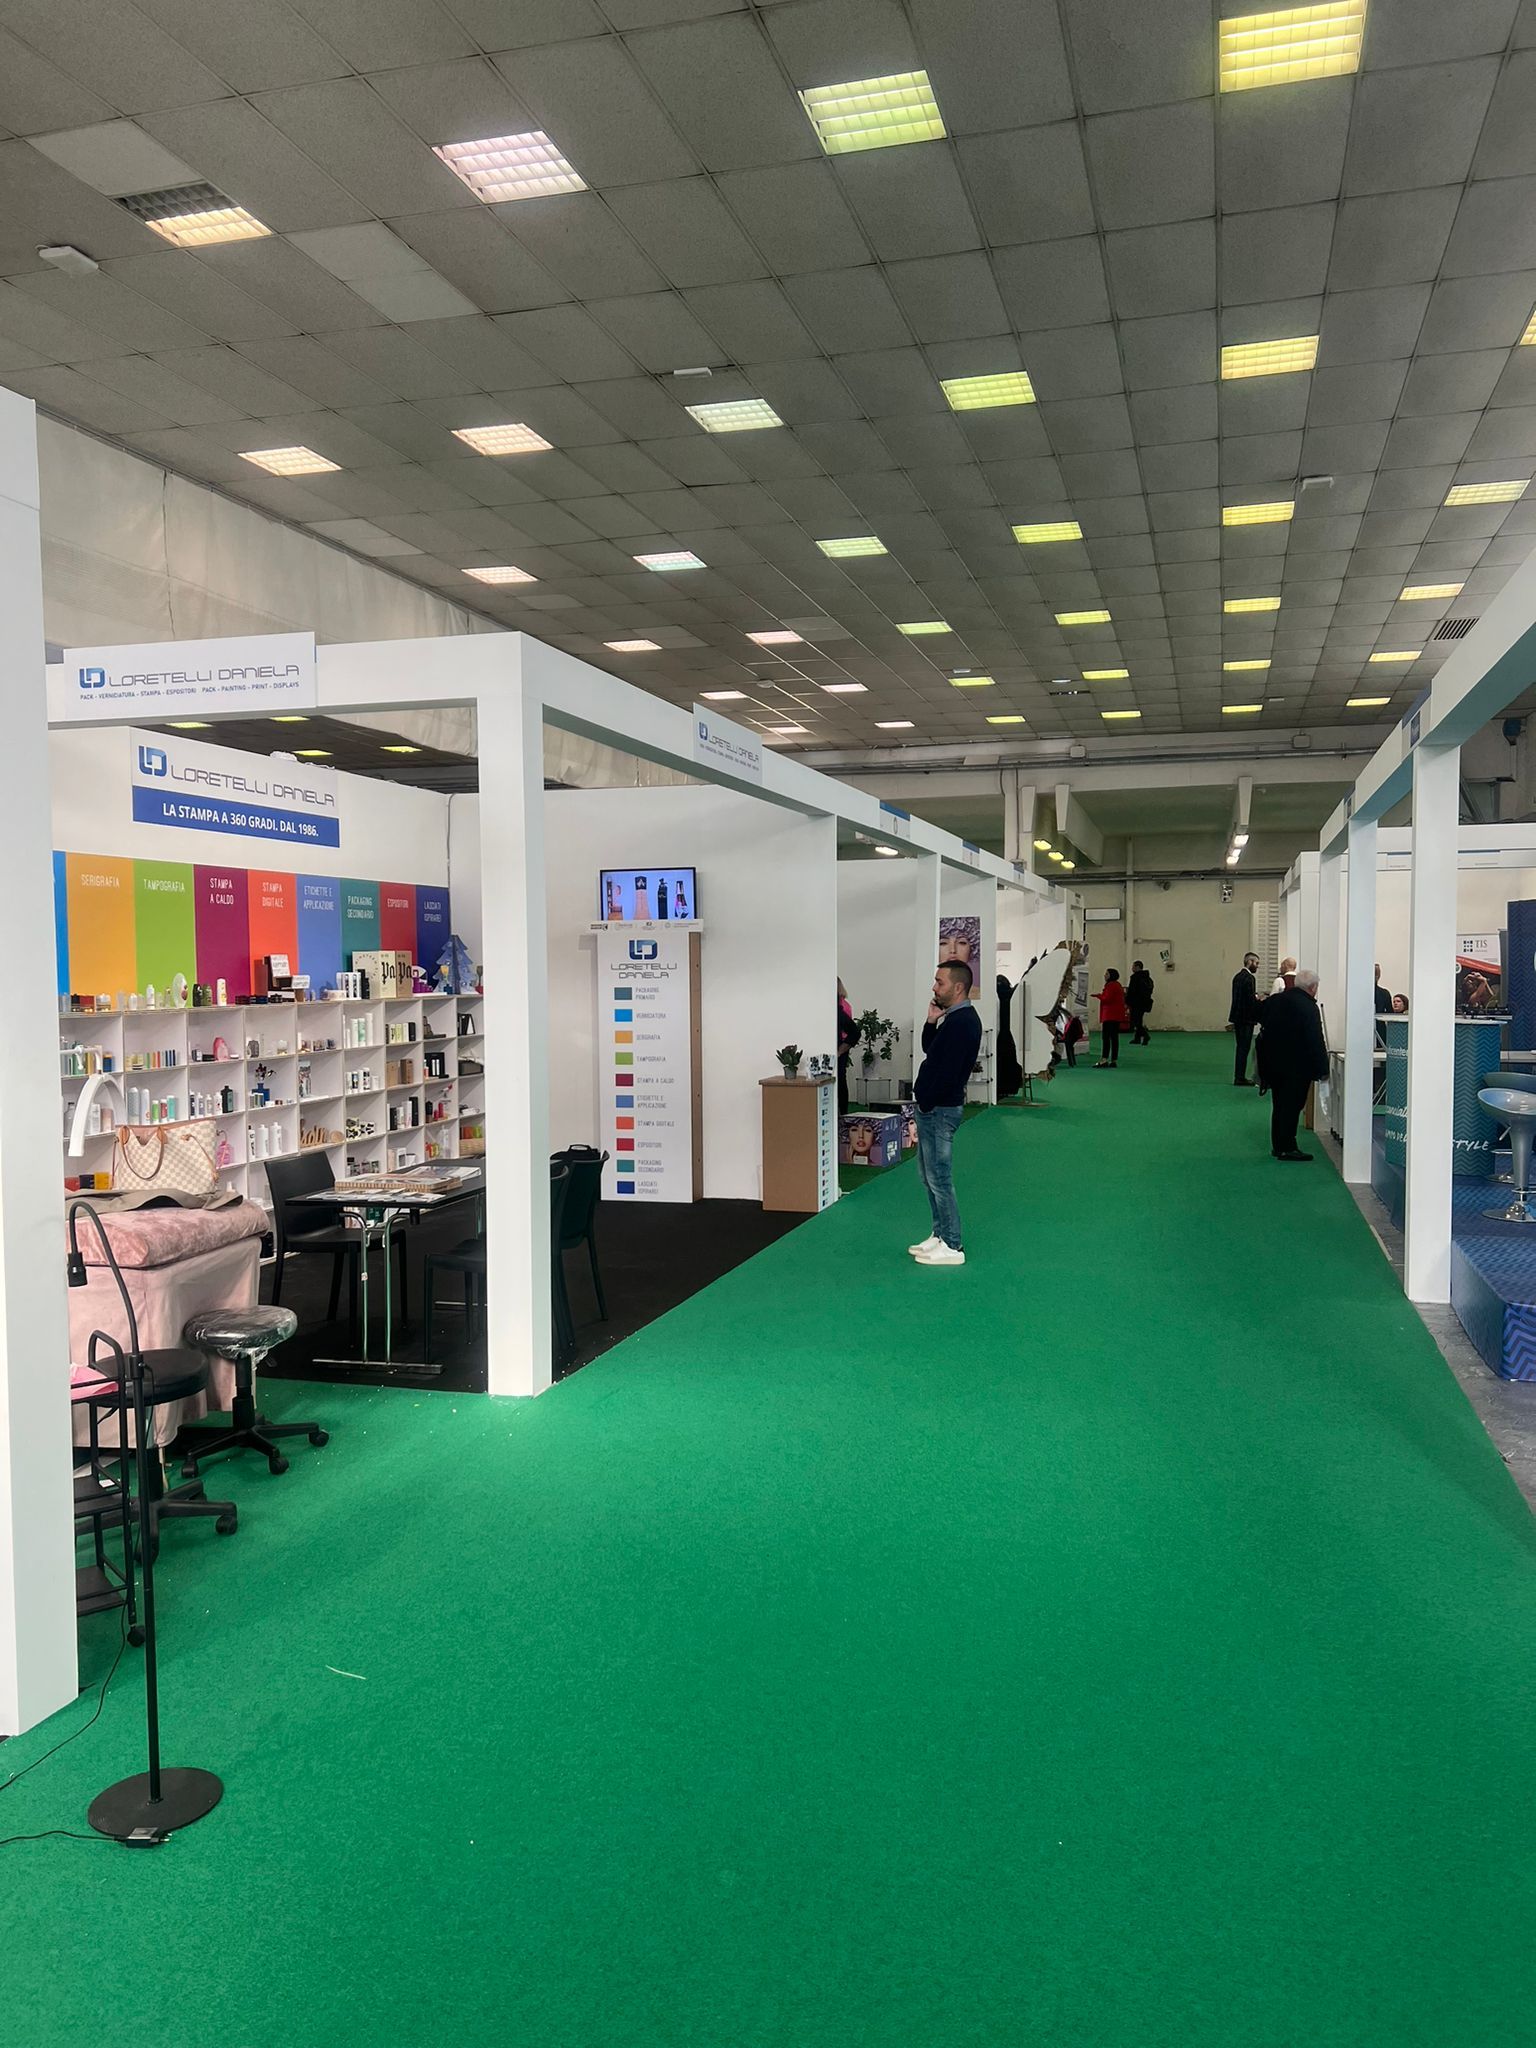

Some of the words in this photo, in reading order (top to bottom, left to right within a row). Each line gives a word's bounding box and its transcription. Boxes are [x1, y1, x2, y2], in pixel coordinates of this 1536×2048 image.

[109, 670, 212, 687] LORETELLI
[218, 665, 299, 680] DANIELA
[222, 684, 246, 692] PAINTING
[273, 681, 299, 689] DISPLAYS
[171, 765, 268, 795] LORETELLI
[273, 783, 335, 807] DANIELA
[162, 802, 177, 817] LA
[178, 806, 220, 823] STAMPA
[221, 815, 229, 825] A
[230, 813, 247, 827] 360
[248, 816, 279, 831] GRADI.
[280, 820, 297, 834] DAL
[298, 823, 319, 837] 1986.
[81, 874, 120, 888] SERIGRAFIA
[144, 879, 186, 892] TAMPOGRAFIA
[210, 878, 233, 890] STAMPA
[262, 882, 282, 892] STAMPA
[210, 894, 214, 903] A
[216, 894, 234, 904] CALDO
[262, 897, 284, 908] DIGITALE
[348, 895, 373, 906] PACKAGING
[1475, 939, 1488, 949] TIS
[611, 962, 678, 970] LORETELLI
[619, 971, 670, 979] DANIELA
[1452, 1139, 1489, 1151] TYLE
